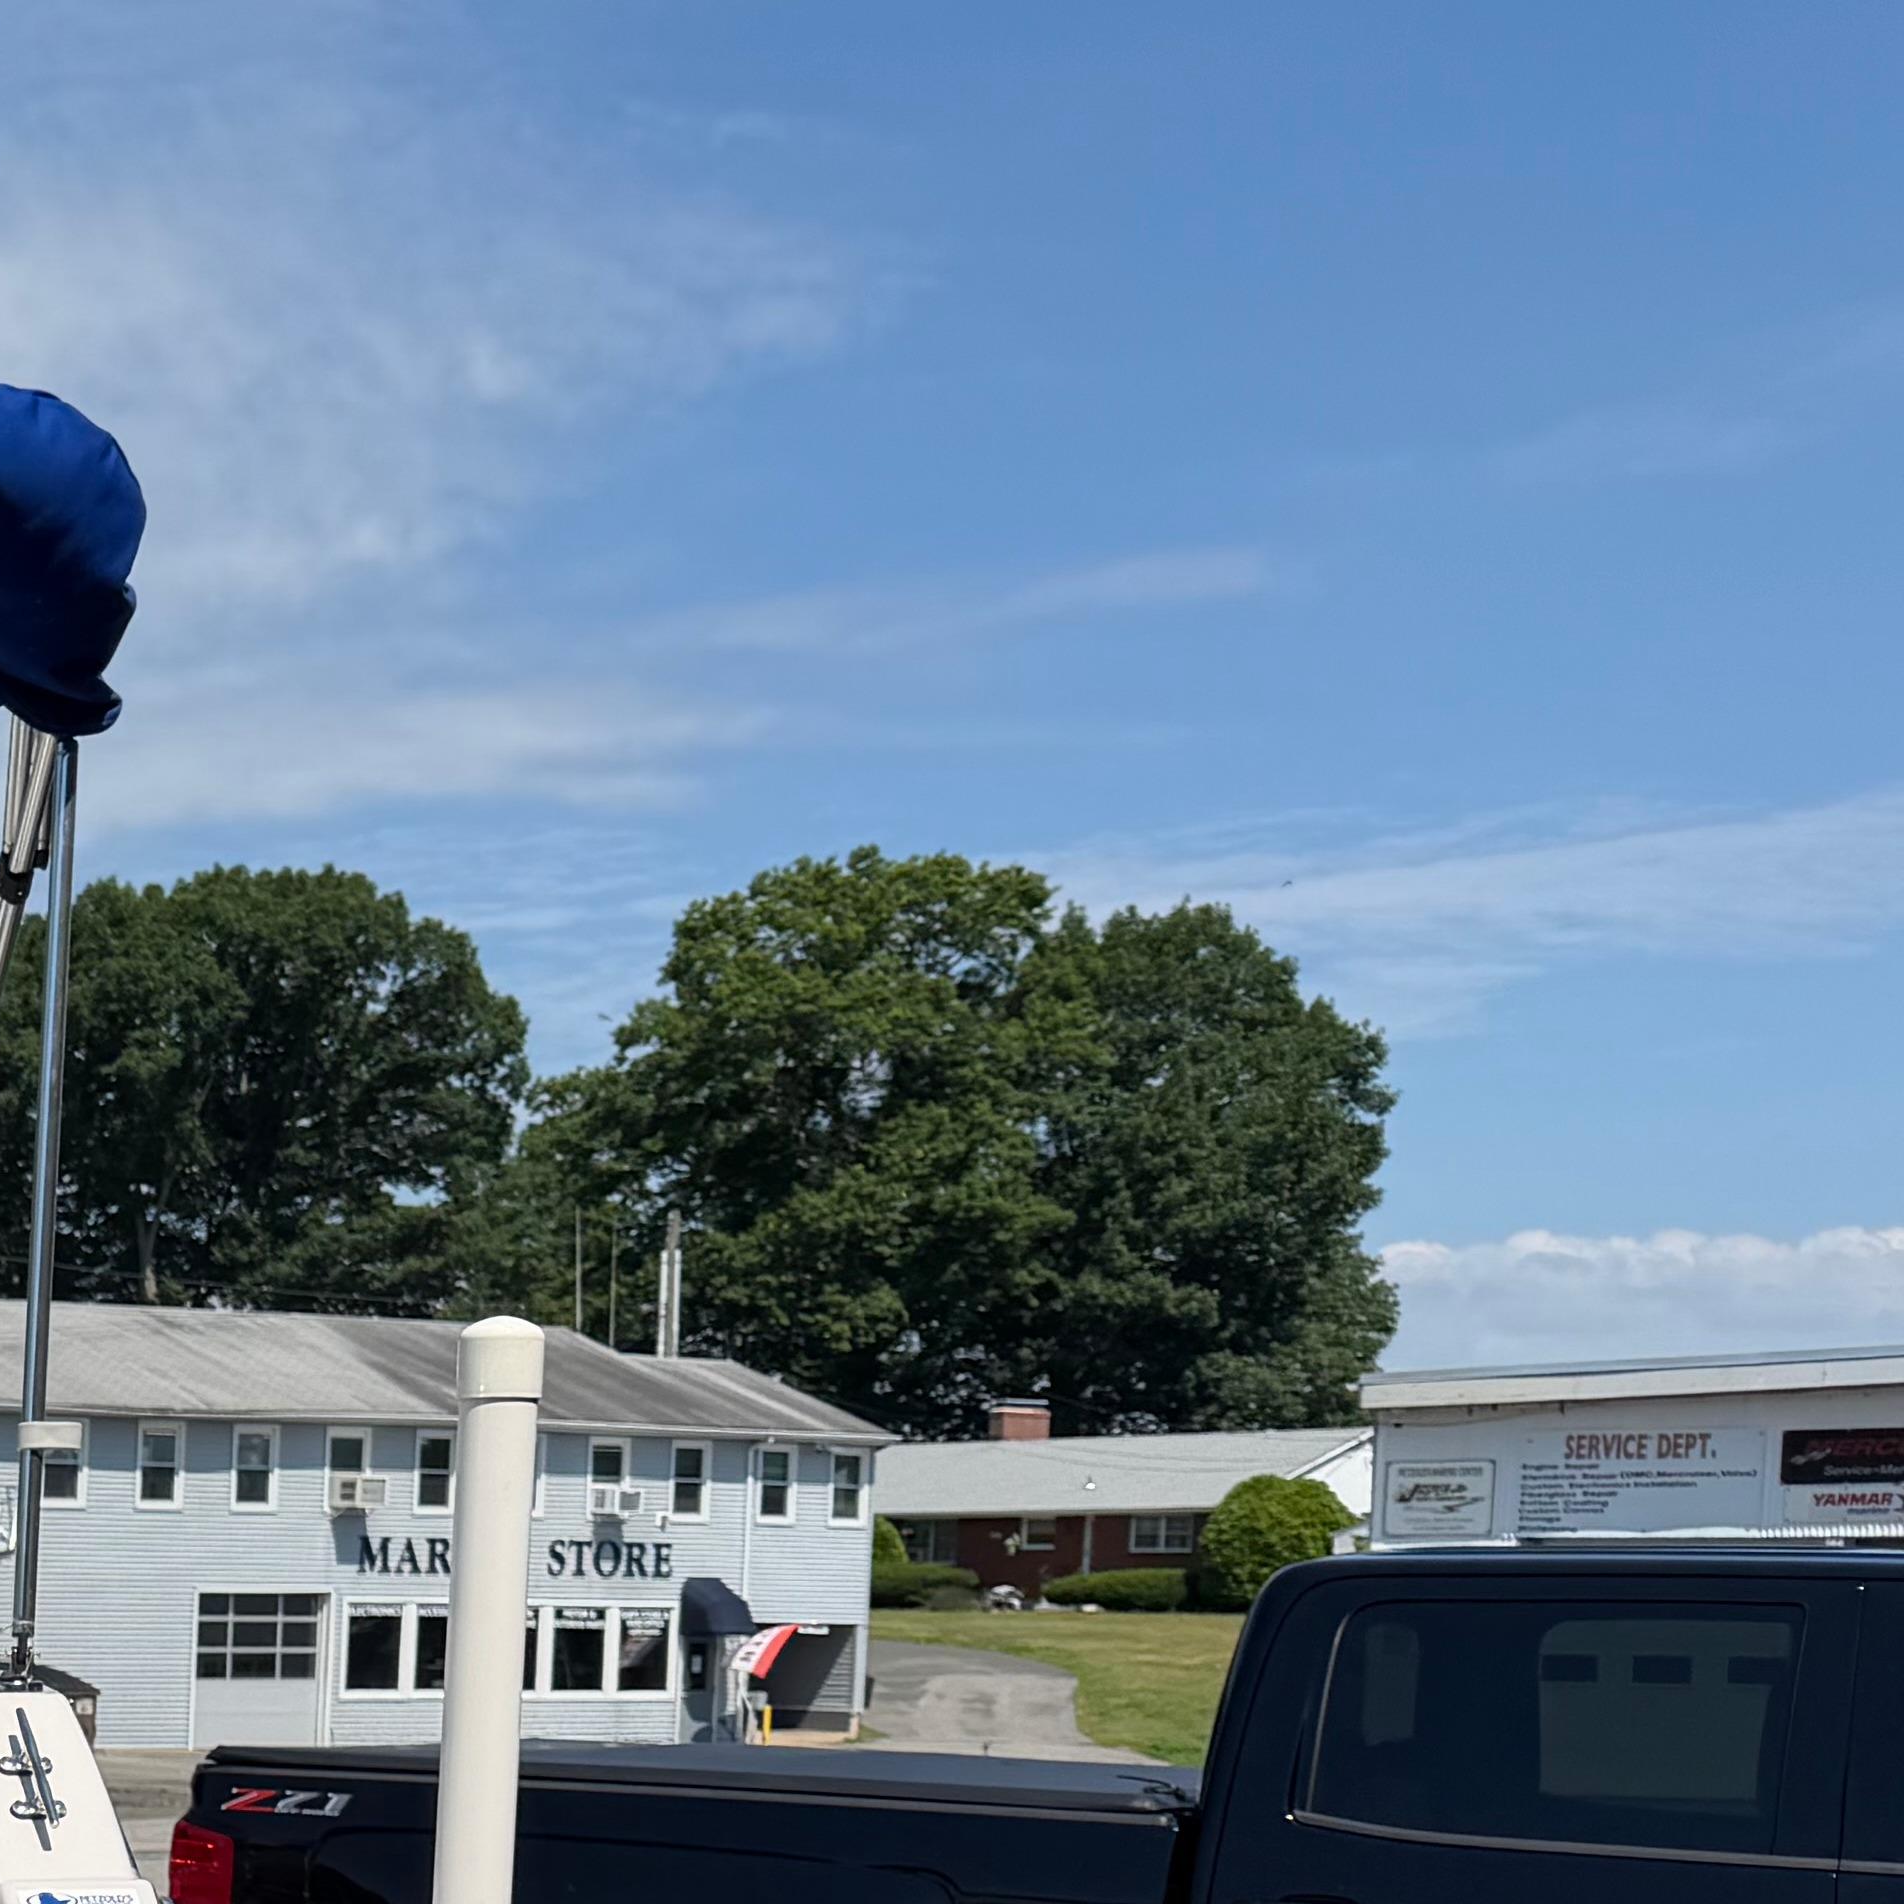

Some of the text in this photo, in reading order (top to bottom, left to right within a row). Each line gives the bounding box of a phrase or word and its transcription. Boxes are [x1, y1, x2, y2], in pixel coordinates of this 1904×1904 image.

[1563, 1432, 1717, 1460] SERVICE DEPT.
[1812, 1492, 1893, 1506] YANMAR
[358, 1536, 673, 1578] MAR STORE
[220, 1787, 353, 1816] Z71
